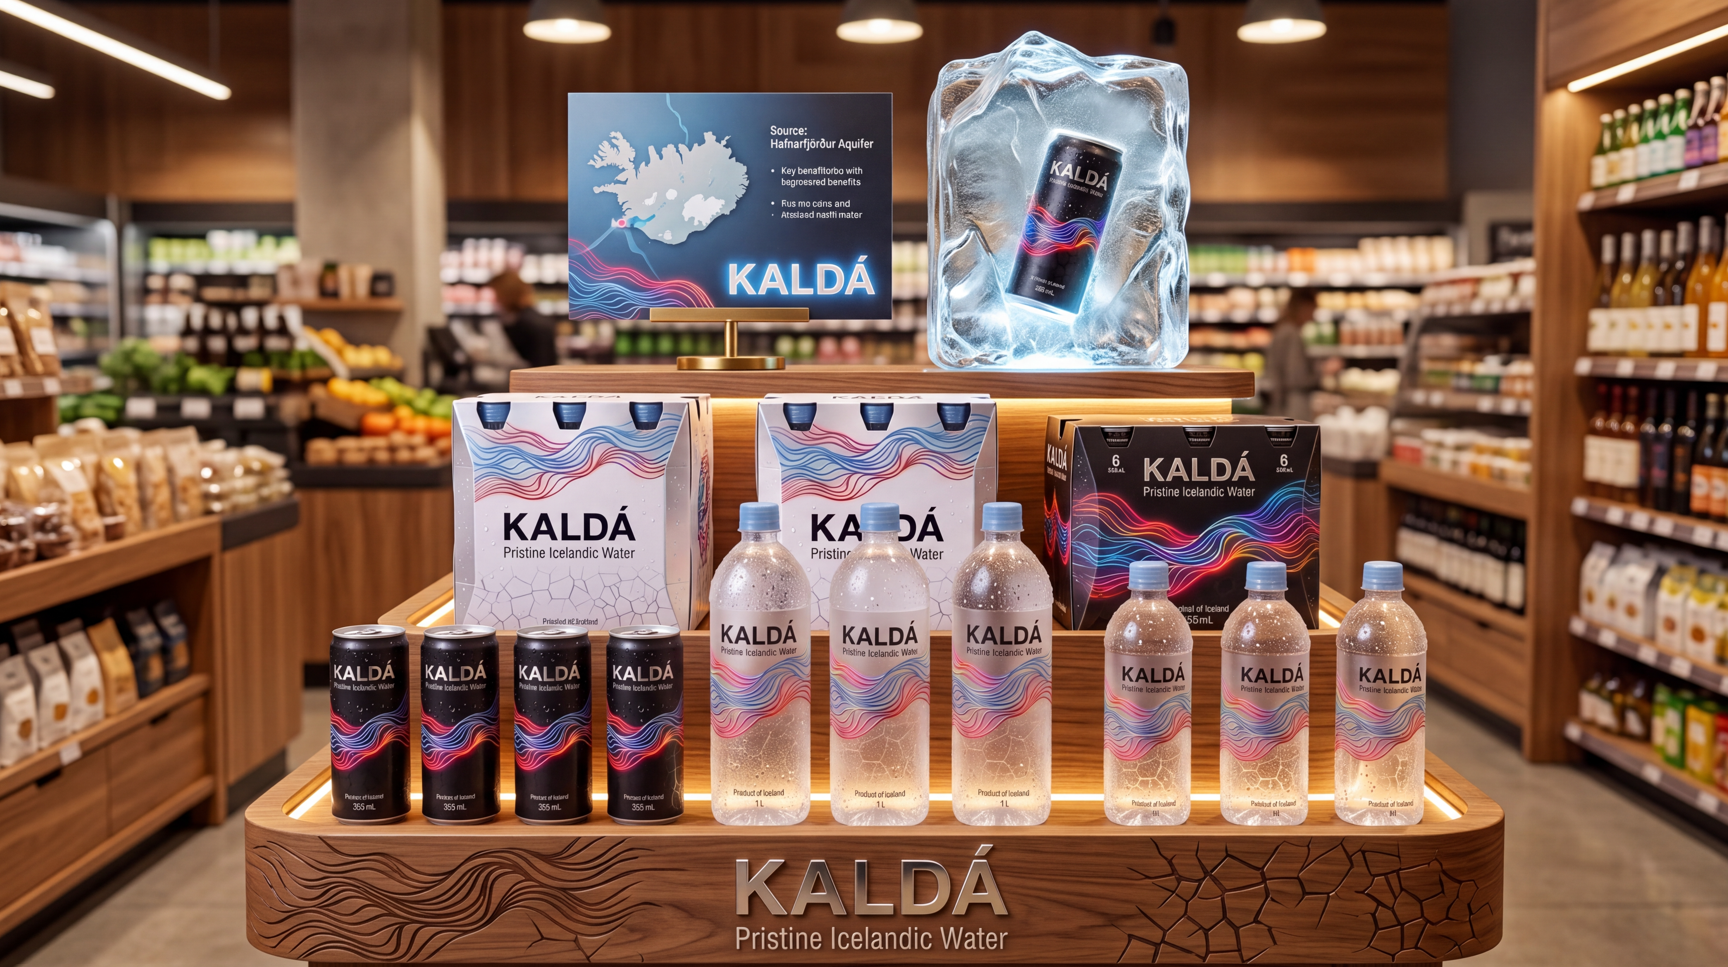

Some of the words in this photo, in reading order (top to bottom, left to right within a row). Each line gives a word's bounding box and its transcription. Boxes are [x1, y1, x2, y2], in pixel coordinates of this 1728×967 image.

[770, 125, 807, 136] Source:
[770, 138, 836, 151] Hafnarfjörður
[838, 138, 874, 151] Aquifer
[781, 166, 796, 177] Key
[846, 166, 863, 175] with
[1049, 161, 1110, 192] KALDÁ
[834, 199, 851, 208] and
[728, 255, 876, 295] KALDÁ
[1112, 454, 1121, 467] 6
[1143, 450, 1256, 482] KALDÁ
[1280, 453, 1289, 467] 6
[1143, 486, 1180, 497] Pristine
[1182, 486, 1225, 497] Icelandic
[1226, 486, 1256, 497] Water
[503, 505, 636, 541] KALDÁ
[811, 506, 944, 542] KADÁ
[503, 546, 546, 559] Pristine
[549, 546, 599, 559] Icelandic
[601, 546, 636, 559] Water
[909, 547, 944, 560] Water
[1196, 604, 1203, 613] of
[1205, 604, 1230, 613] Iceland
[721, 619, 797, 646] KALDÁ
[842, 620, 919, 647] KALDÁ
[966, 619, 1043, 646] KALDÁ
[720, 646, 744, 656] Pristine
[745, 648, 777, 657] Icelandic
[778, 647, 798, 656] Water
[868, 649, 900, 658] Icelandic
[966, 646, 991, 657] Pristine
[992, 648, 1024, 657] Icelandic
[1025, 647, 1043, 656] Water
[333, 659, 396, 682] KALDÁ
[425, 659, 488, 682] KALDÁ
[518, 659, 581, 682] KALDÁ
[612, 659, 674, 682] KALDÁ
[1122, 661, 1186, 684] KALDÁ
[1239, 662, 1304, 684] KALDÁ
[1359, 662, 1422, 684] KALDÁ
[1145, 686, 1172, 694] Icelandic
[1264, 686, 1291, 694] Icelandic
[756, 789, 762, 797] of
[877, 790, 884, 799] of
[977, 788, 1001, 797] Product
[1001, 789, 1008, 798] of
[456, 802, 467, 811] mL
[551, 802, 562, 811] mL
[645, 803, 656, 811] mL
[876, 800, 880, 809] 1
[881, 800, 886, 809] L
[1000, 799, 1004, 808] 1
[1005, 799, 1010, 808] L
[735, 843, 1009, 917] KALDÁ
[735, 926, 822, 950] Pristine
[831, 926, 933, 950] Icelandic
[940, 926, 1009, 950] Water
